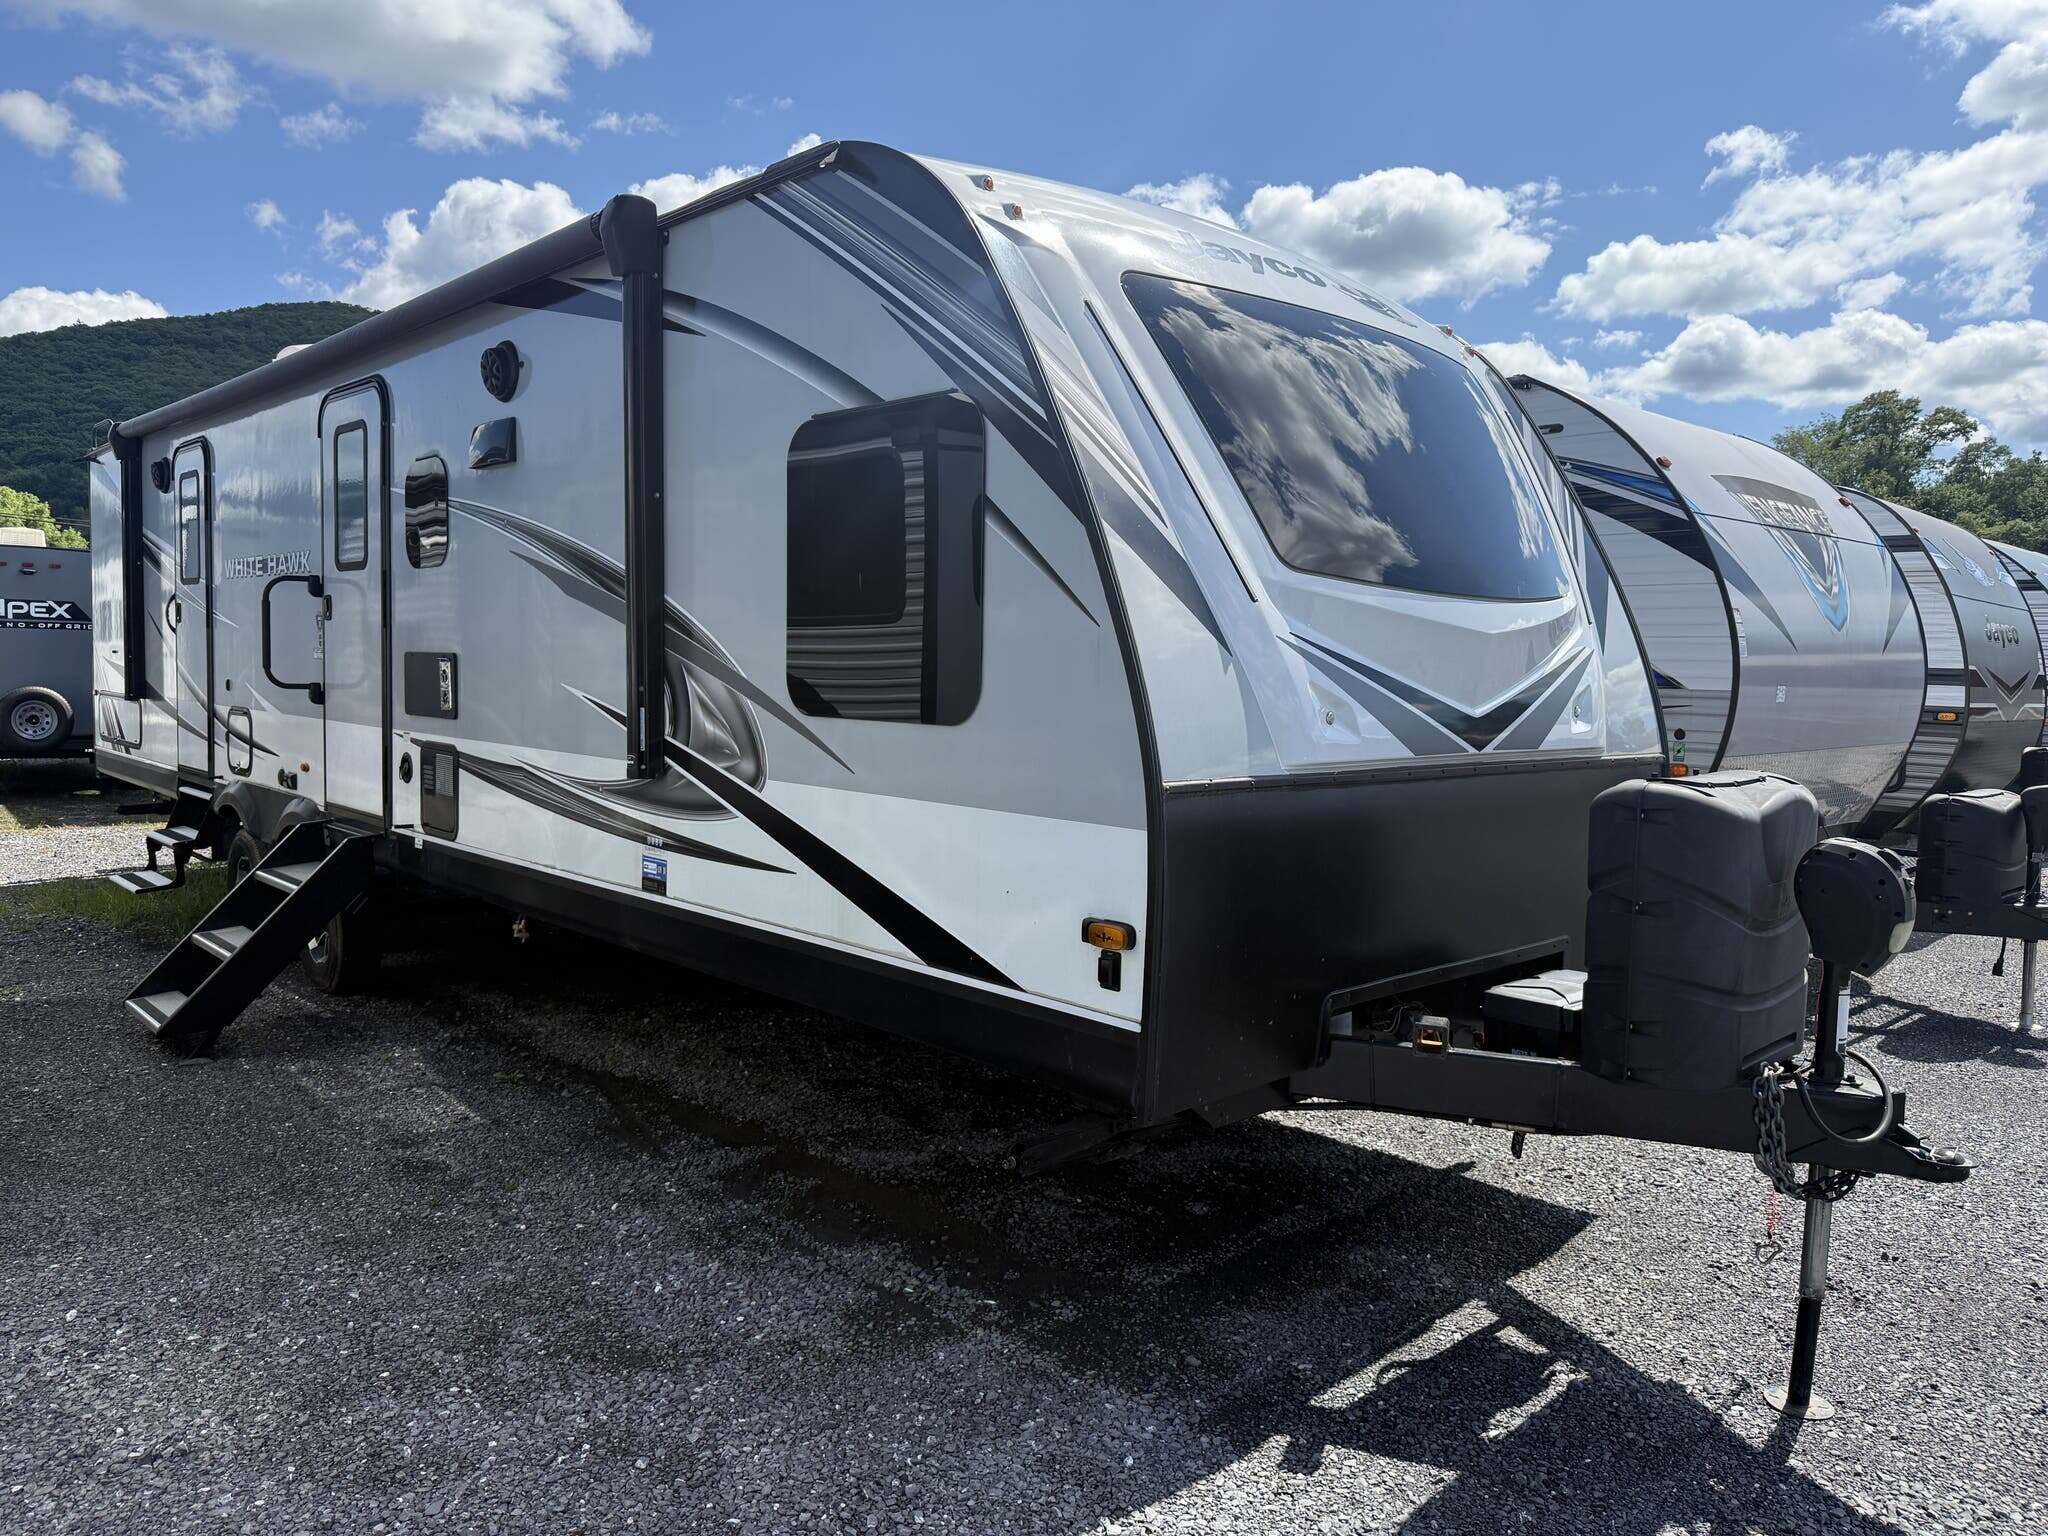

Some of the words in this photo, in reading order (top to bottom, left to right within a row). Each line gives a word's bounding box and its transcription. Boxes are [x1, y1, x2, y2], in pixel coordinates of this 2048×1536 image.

[1178, 230, 1327, 288] Jayco
[225, 556, 263, 578] WHITE
[267, 550, 311, 575] HAWK
[1984, 614, 2019, 648] Jayco
